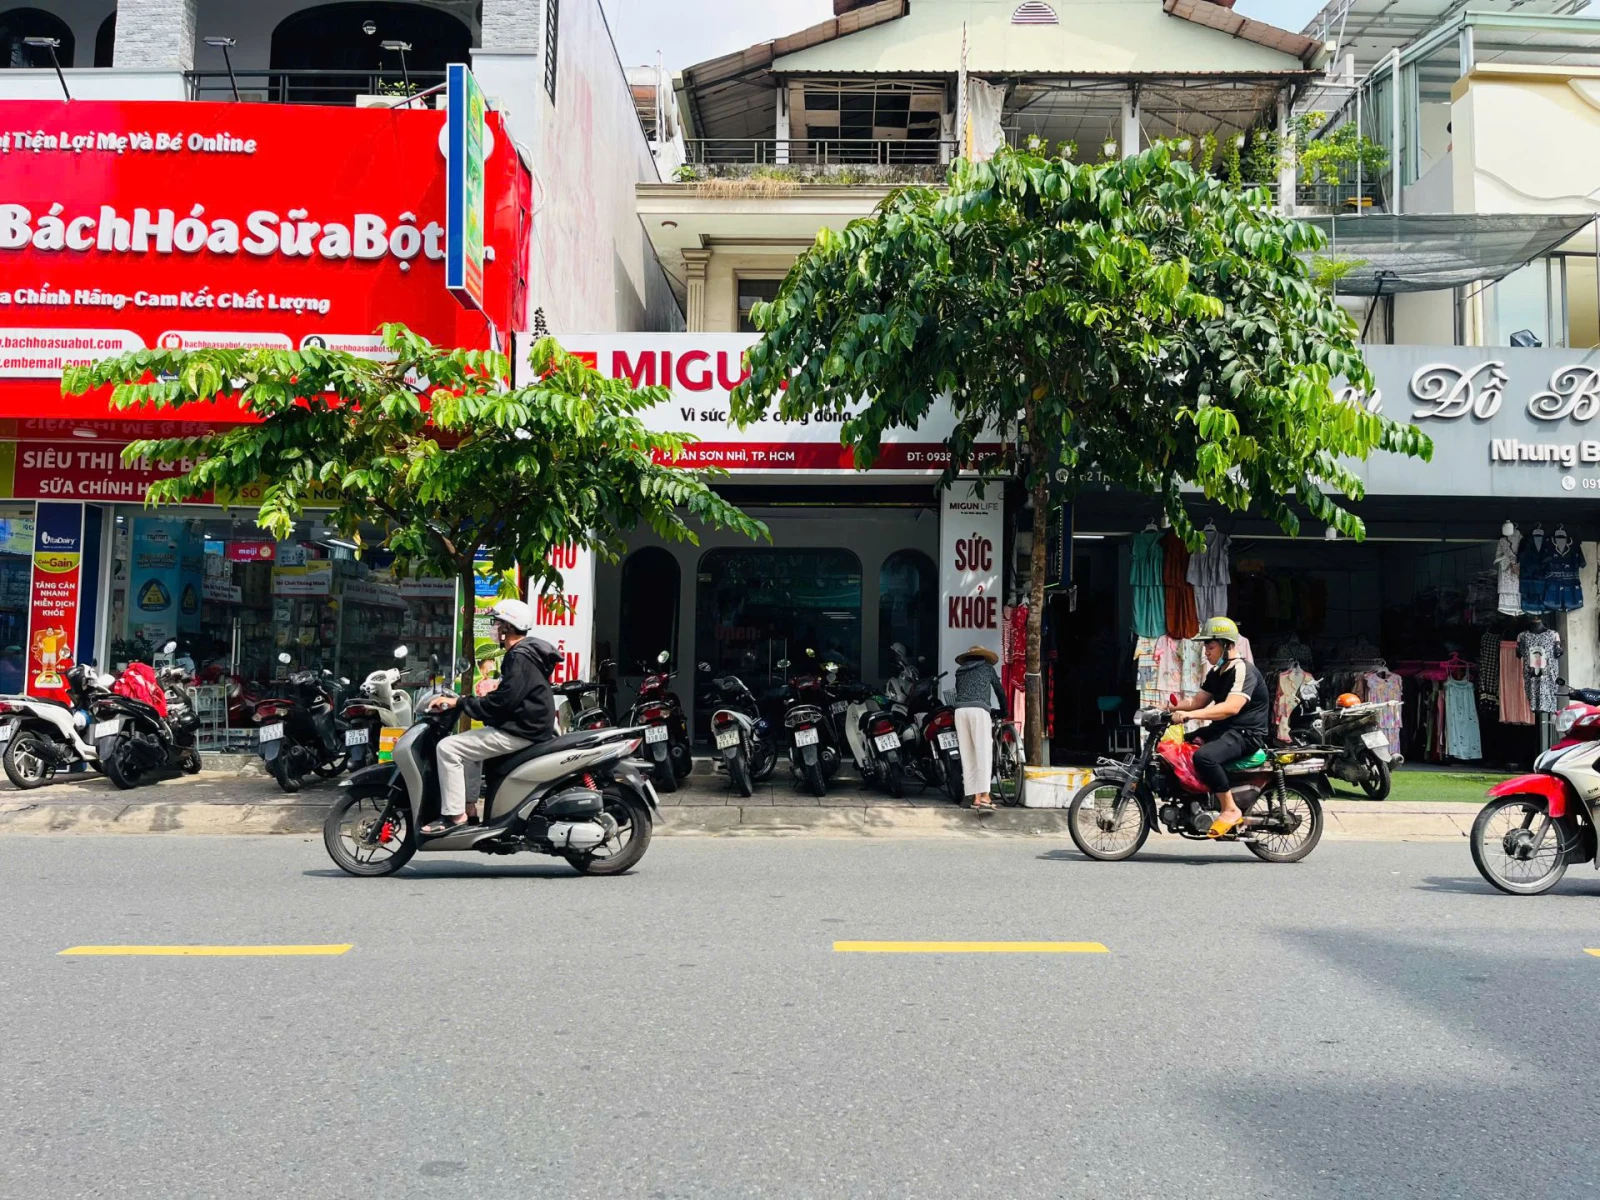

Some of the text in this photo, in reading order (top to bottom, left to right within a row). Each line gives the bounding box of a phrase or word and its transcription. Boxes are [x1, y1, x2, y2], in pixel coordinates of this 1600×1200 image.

[12, 129, 57, 153] Tiện
[59, 130, 95, 153] Lợi
[155, 132, 183, 151] Bé
[187, 131, 257, 153] Online
[14, 282, 71, 305] Chính
[179, 285, 215, 308] Kết
[217, 288, 264, 309] Chất
[268, 293, 331, 315] Lượng
[1410, 360, 1510, 420] Đồ
[680, 407, 696, 422] Vì
[700, 407, 726, 422] sức
[23, 447, 72, 469] SIÊU
[77, 452, 114, 475] THỊ
[157, 456, 174, 472] &
[699, 449, 724, 461] SƠN
[751, 451, 767, 461] TP.
[769, 451, 795, 461] HCM
[906, 452, 924, 461] ĐT:
[1490, 438, 1577, 467] Nhung
[39, 477, 74, 494] SỮA
[78, 478, 133, 495] CHÍNH
[949, 502, 979, 510] MIGUN
[238, 547, 258, 556] meiji
[954, 531, 992, 572] SỨC
[948, 585, 997, 629] KHỎE
